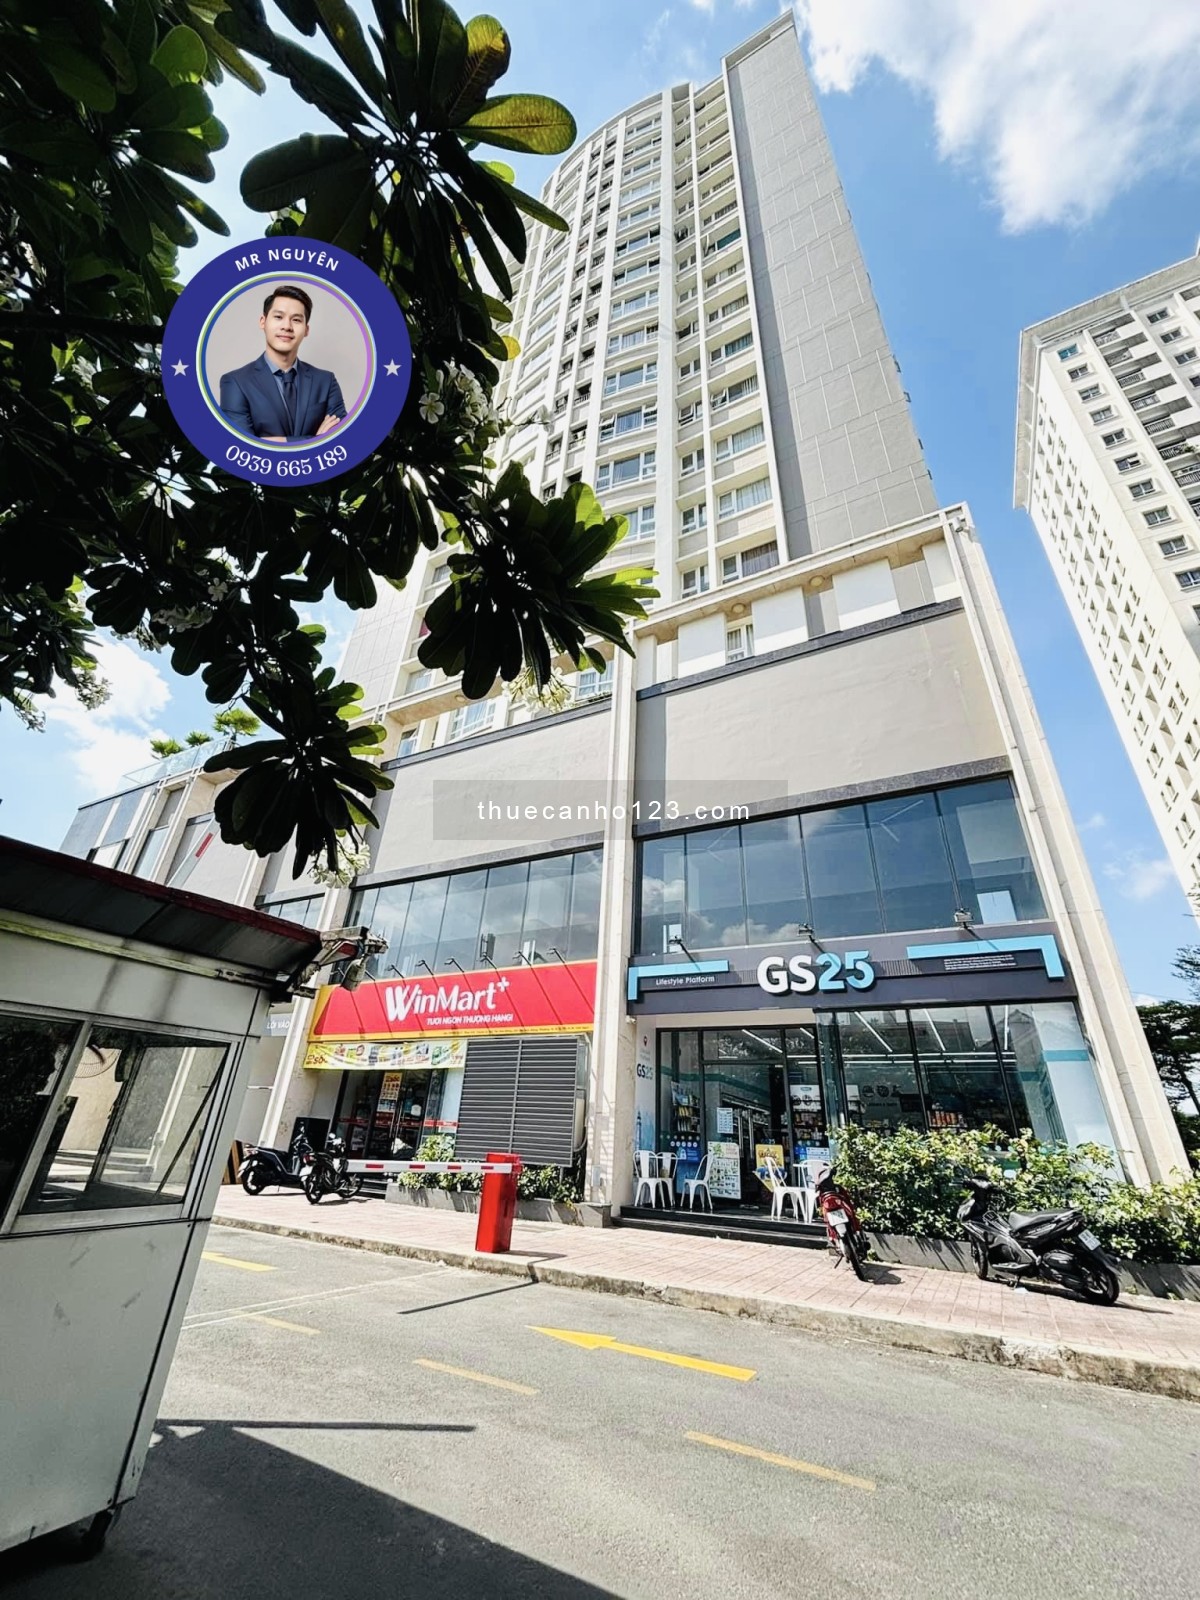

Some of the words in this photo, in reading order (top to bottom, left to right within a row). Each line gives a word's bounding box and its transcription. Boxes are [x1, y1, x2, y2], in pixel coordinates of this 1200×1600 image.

[757, 950, 875, 993] GS25
[655, 977, 684, 986] Lifestyle
[685, 975, 715, 984] Platform
[636, 1063, 654, 1080] GS25
